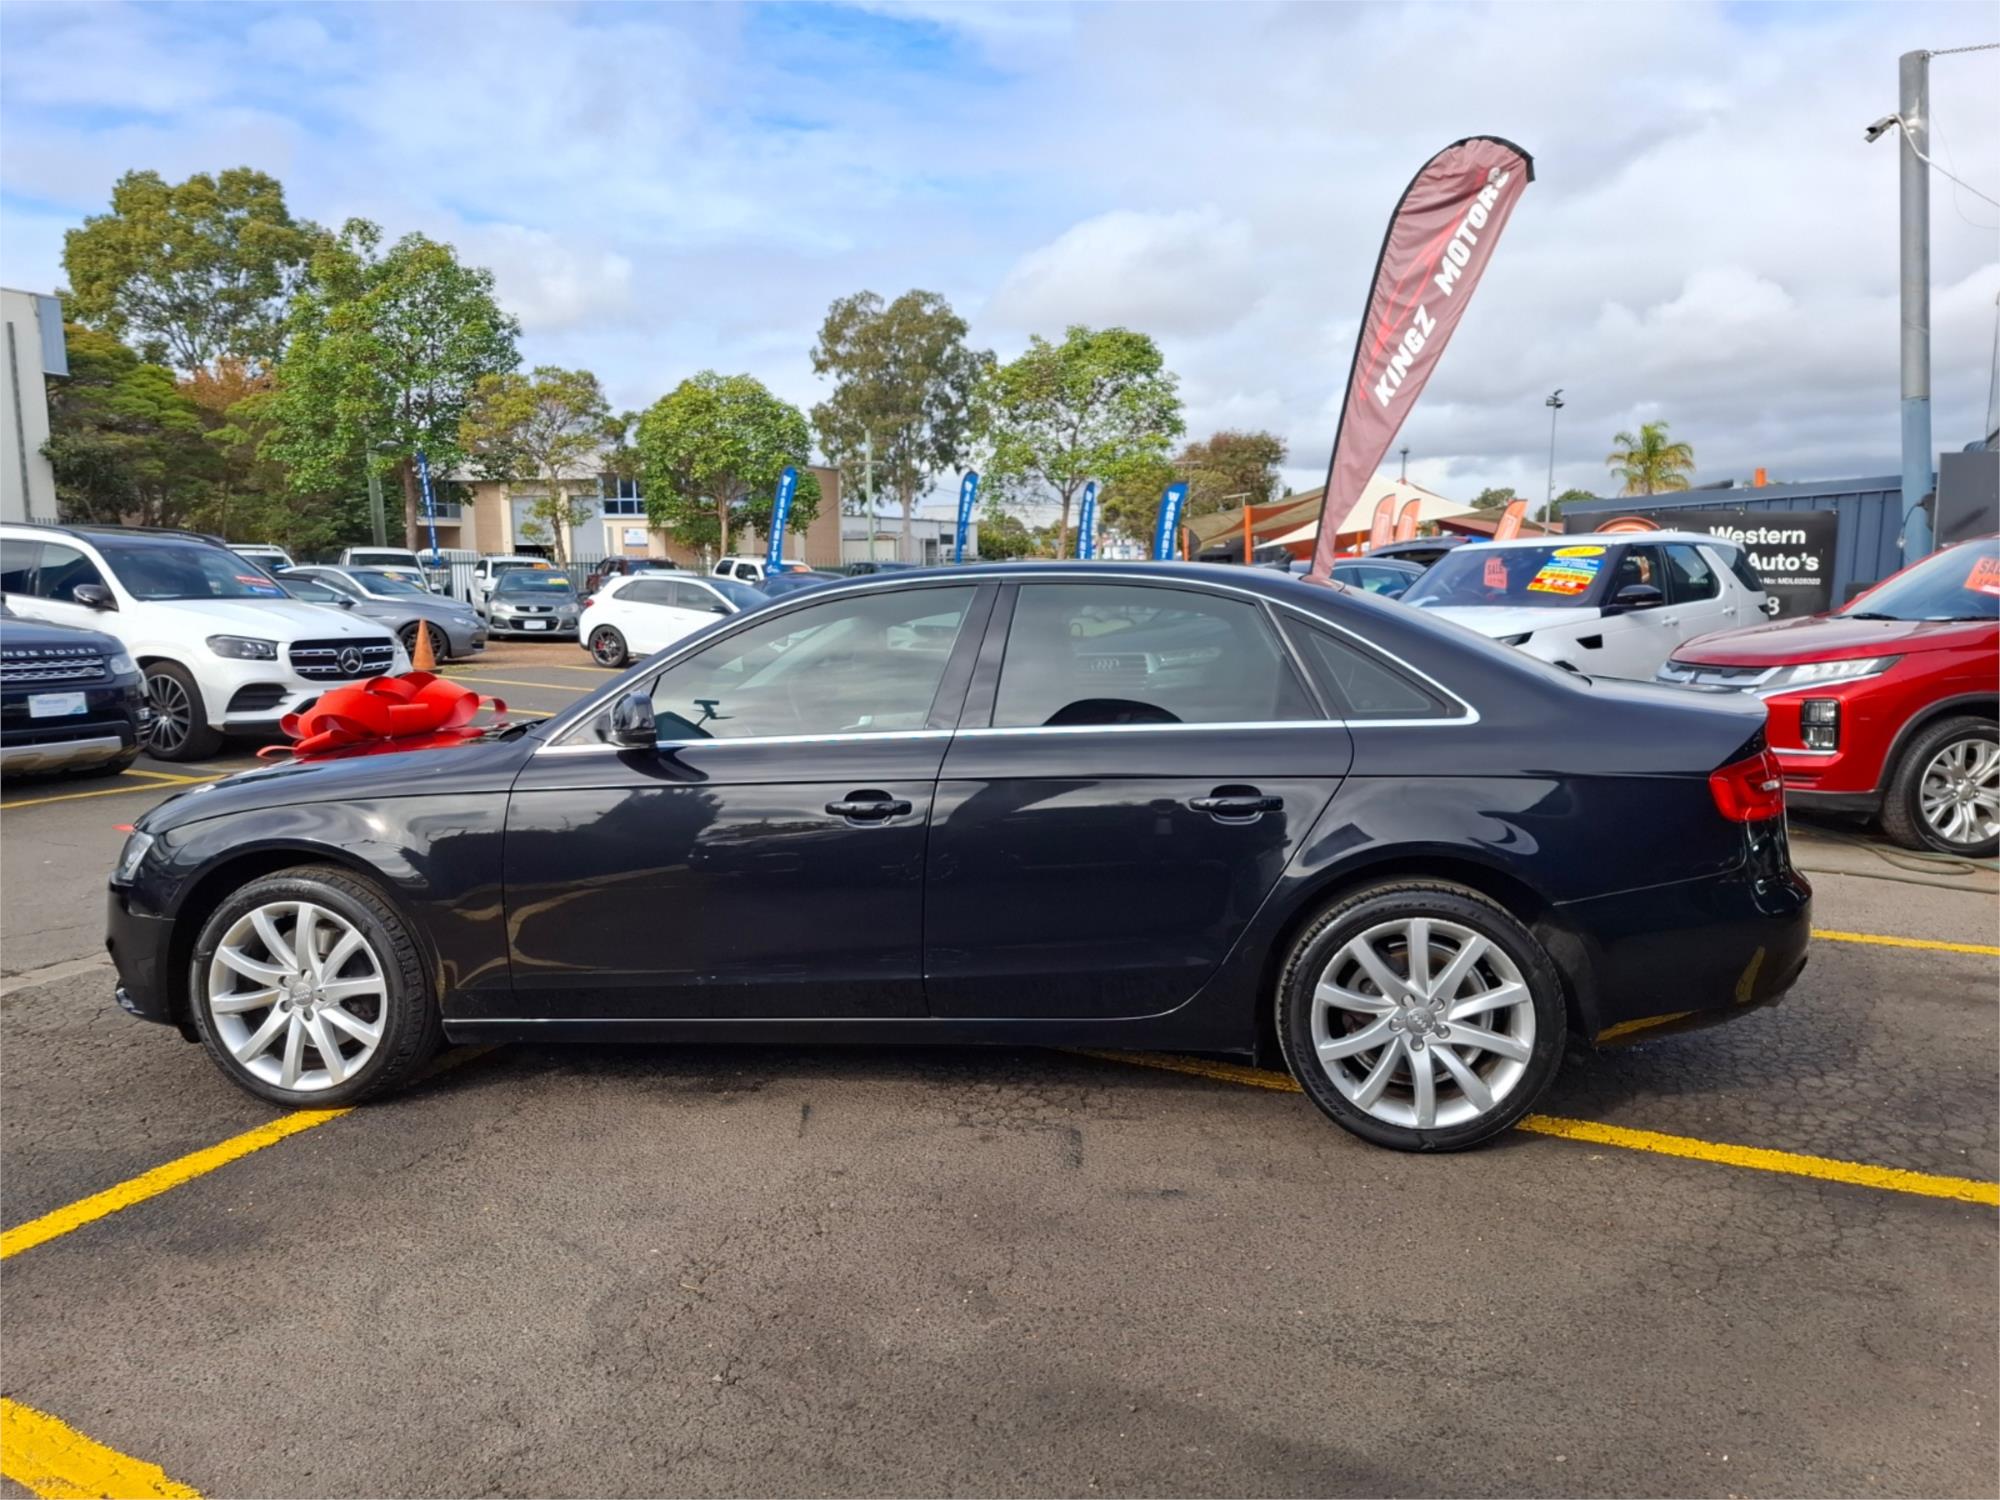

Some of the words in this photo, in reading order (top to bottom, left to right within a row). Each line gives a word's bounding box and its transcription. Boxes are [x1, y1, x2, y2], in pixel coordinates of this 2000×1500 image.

[1374, 304, 1437, 408] KINGZ
[1434, 167, 1510, 297] MOTORS
[1080, 490, 1094, 560] WARRANT
[1161, 491, 1180, 560] WARRANT
[1709, 526, 1806, 544] Western
[1748, 552, 1819, 571] Auto's
[45, 647, 97, 656] ROVER
